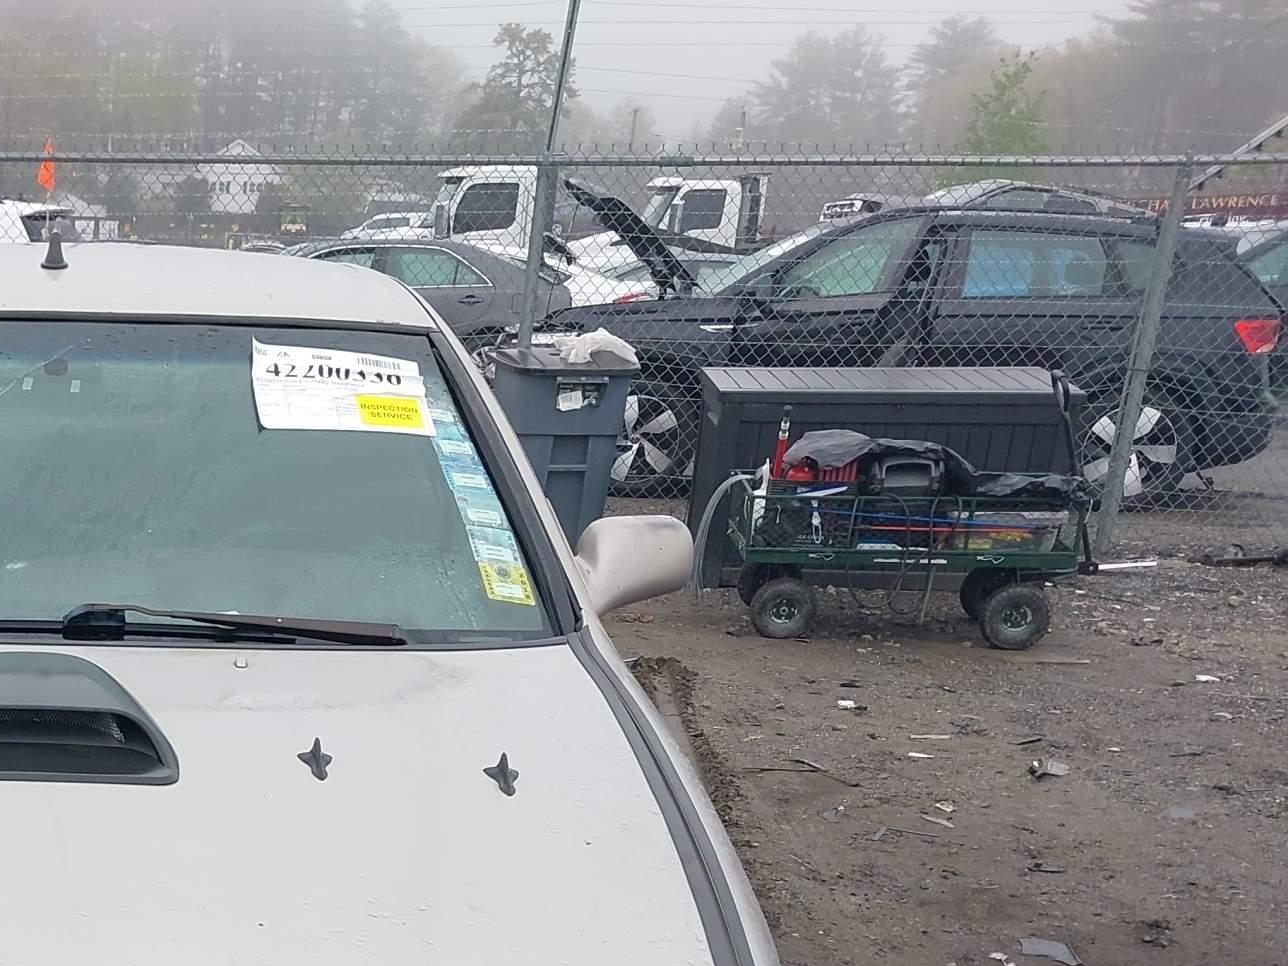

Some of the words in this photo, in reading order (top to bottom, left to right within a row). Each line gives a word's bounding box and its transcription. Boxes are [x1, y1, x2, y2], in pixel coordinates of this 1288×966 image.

[1191, 193, 1281, 210] LAWRENCE
[360, 402, 419, 414] INSPECTION
[369, 411, 413, 421] SERVICE
